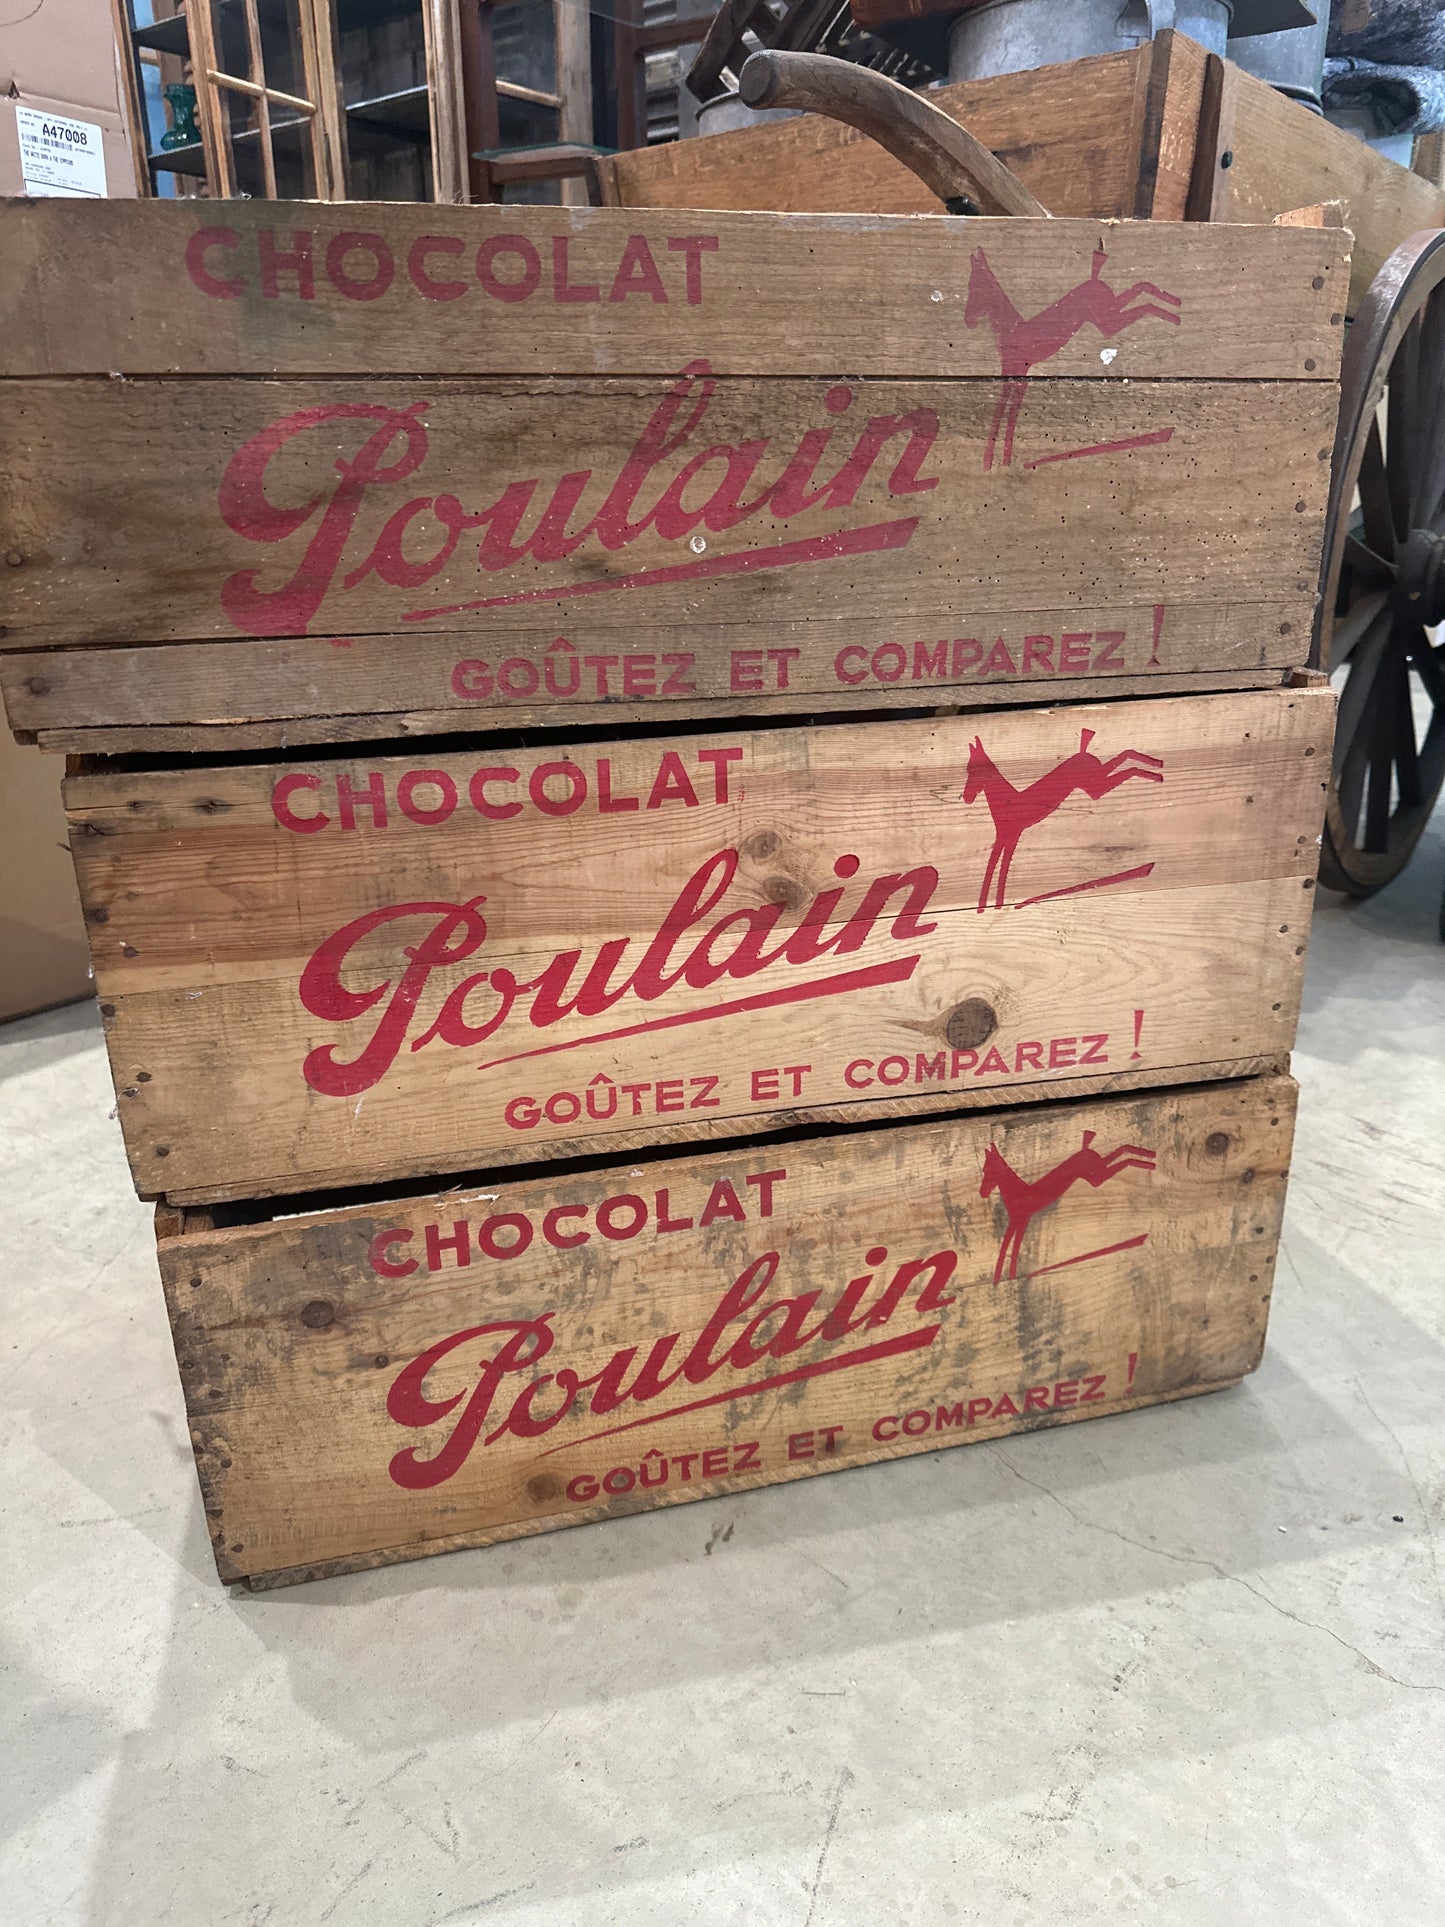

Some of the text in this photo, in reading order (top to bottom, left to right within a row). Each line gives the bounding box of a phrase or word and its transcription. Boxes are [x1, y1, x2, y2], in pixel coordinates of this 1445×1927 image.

[42, 123, 87, 145] A47008
[184, 226, 720, 306] CHOCOLAT
[217, 358, 941, 639] Poulain
[451, 637, 695, 701] GOÛTEZ
[731, 649, 801, 692] ET
[272, 747, 745, 836] CHOCOLAT
[299, 847, 941, 1099] Poulain
[504, 1073, 722, 1132] GOÛTEZ
[751, 1065, 813, 1103] ET
[367, 1169, 788, 1281] CHOCOLAT
[386, 1250, 959, 1492] Poulain
[567, 1449, 762, 1503] GOÛTEZ
[788, 1426, 844, 1462] ET
